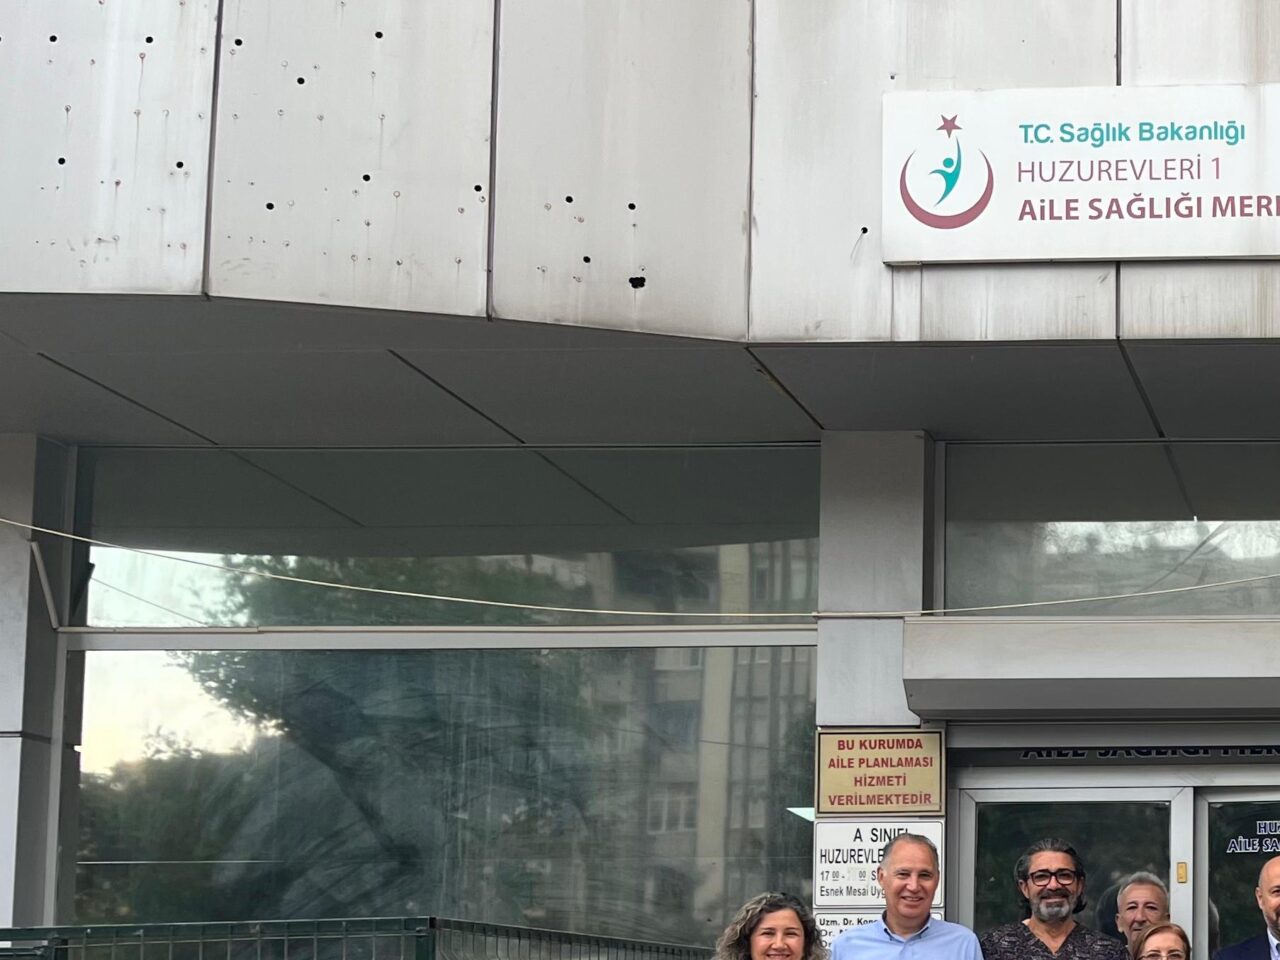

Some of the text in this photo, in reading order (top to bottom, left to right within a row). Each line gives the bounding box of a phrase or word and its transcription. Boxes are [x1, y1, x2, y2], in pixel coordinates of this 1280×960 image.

[1018, 119, 1246, 148] T.C. Sağlık Bakanlığı
[1016, 154, 1222, 183] HUZUREVLERİ 1
[1087, 192, 1201, 220] SAĞLIĞI
[837, 738, 923, 750] BU KURUMDA
[828, 755, 934, 769] AİLE PLANLAMASI
[853, 772, 907, 787] HİZMETİ
[828, 791, 932, 807] VERİLMEKTEDİR
[853, 827, 864, 843] A
[1226, 836, 1260, 853] AİLE
[820, 848, 884, 864] HUZUREVLE
[820, 885, 844, 897] Esnek
[846, 885, 869, 897] Mesai
[819, 917, 841, 926] Uzm.
[843, 917, 854, 926] Dr.
